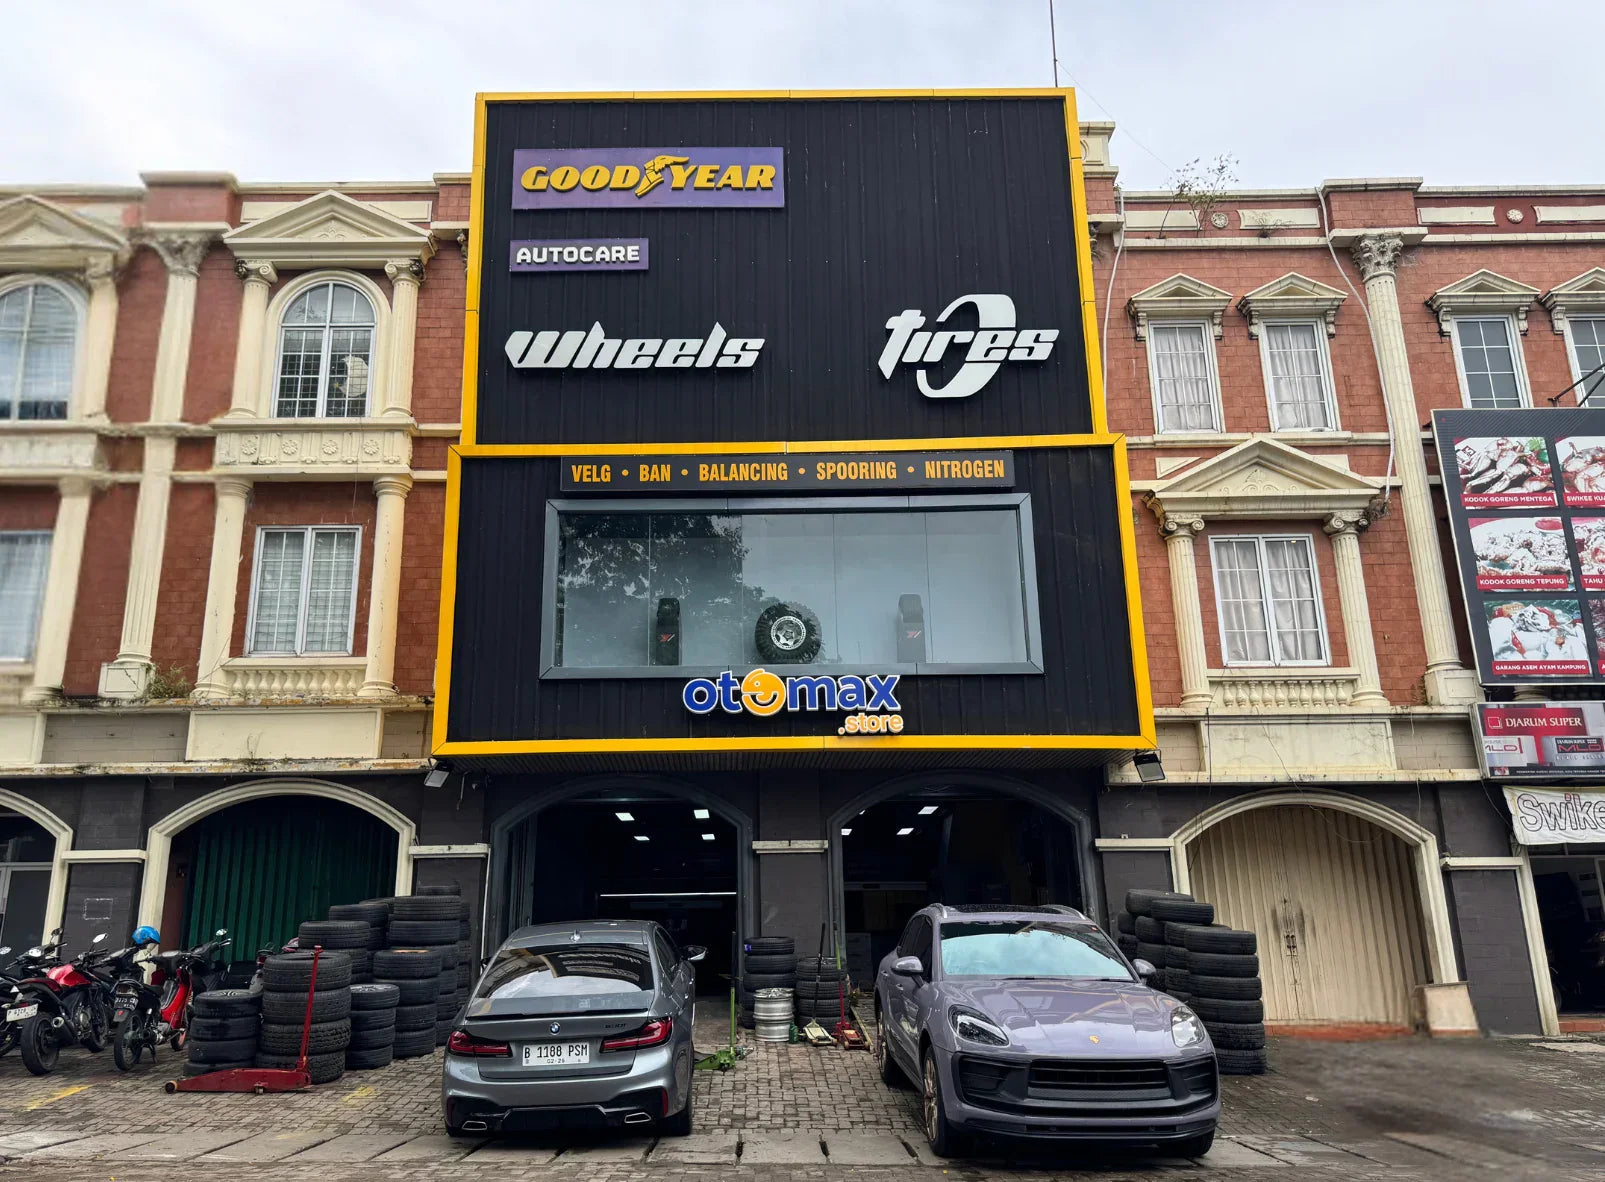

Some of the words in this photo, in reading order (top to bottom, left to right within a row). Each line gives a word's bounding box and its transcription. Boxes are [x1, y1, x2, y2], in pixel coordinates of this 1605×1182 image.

[521, 162, 776, 193] GOODYEAR
[516, 246, 639, 263] AUTOCARE
[878, 300, 1060, 390] tires
[571, 464, 611, 482] VELG
[639, 464, 671, 482] BAN
[699, 463, 788, 481] BALANCING
[816, 461, 897, 480] SPOORING
[925, 460, 1004, 478] NITROGEN
[683, 668, 901, 716] otomax
[1505, 717, 1547, 727] DJARUM
[1549, 717, 1582, 727] SUPER
[524, 1047, 530, 1058] B
[537, 1045, 562, 1058] 1188
[568, 1044, 588, 1056] PSM
